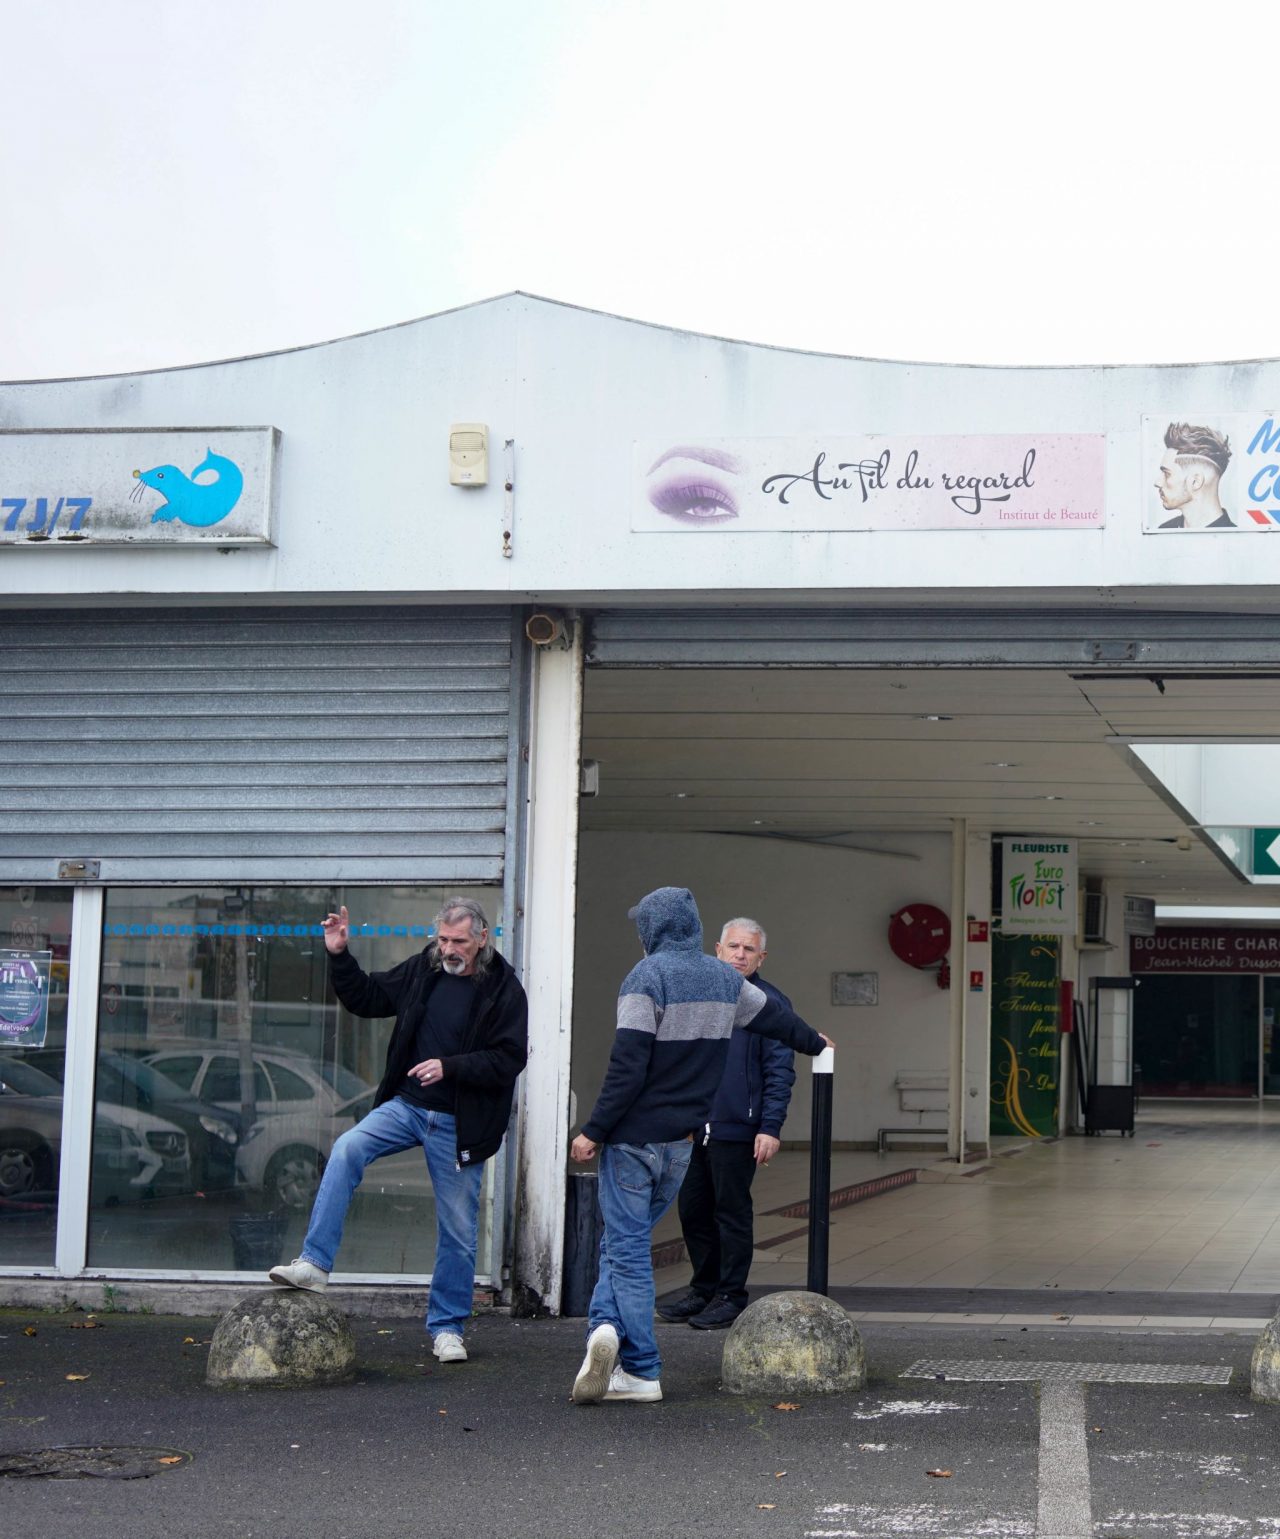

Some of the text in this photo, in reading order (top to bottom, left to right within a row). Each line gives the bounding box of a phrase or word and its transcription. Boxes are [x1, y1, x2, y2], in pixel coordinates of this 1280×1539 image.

[762, 452, 851, 504] Au
[897, 449, 934, 489] du
[942, 448, 1036, 515] regard
[1, 497, 92, 535] 7J/7
[999, 507, 1098, 520] Institut de Beauté
[1012, 844, 1069, 853] FLEURISTE
[1034, 859, 1063, 879] Euro
[1009, 873, 1064, 911] Florist
[1134, 937, 1226, 950] BOUCHERIE
[1145, 955, 1234, 969] Jean-Michel
